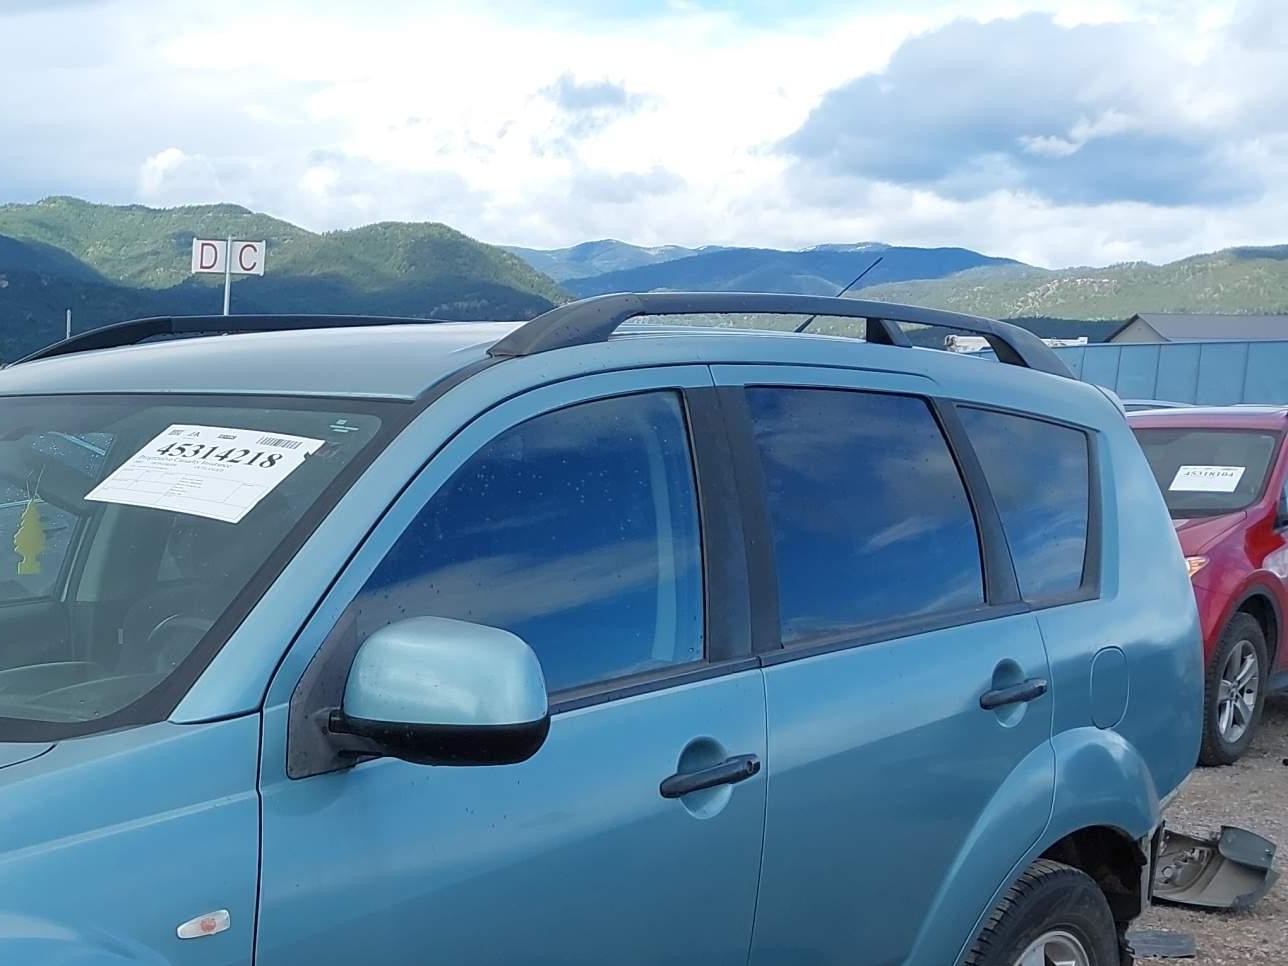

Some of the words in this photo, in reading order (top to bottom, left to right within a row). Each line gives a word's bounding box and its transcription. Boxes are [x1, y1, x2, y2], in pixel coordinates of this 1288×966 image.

[199, 243, 218, 270] D
[239, 244, 257, 271] C
[156, 441, 283, 469] 45314218
